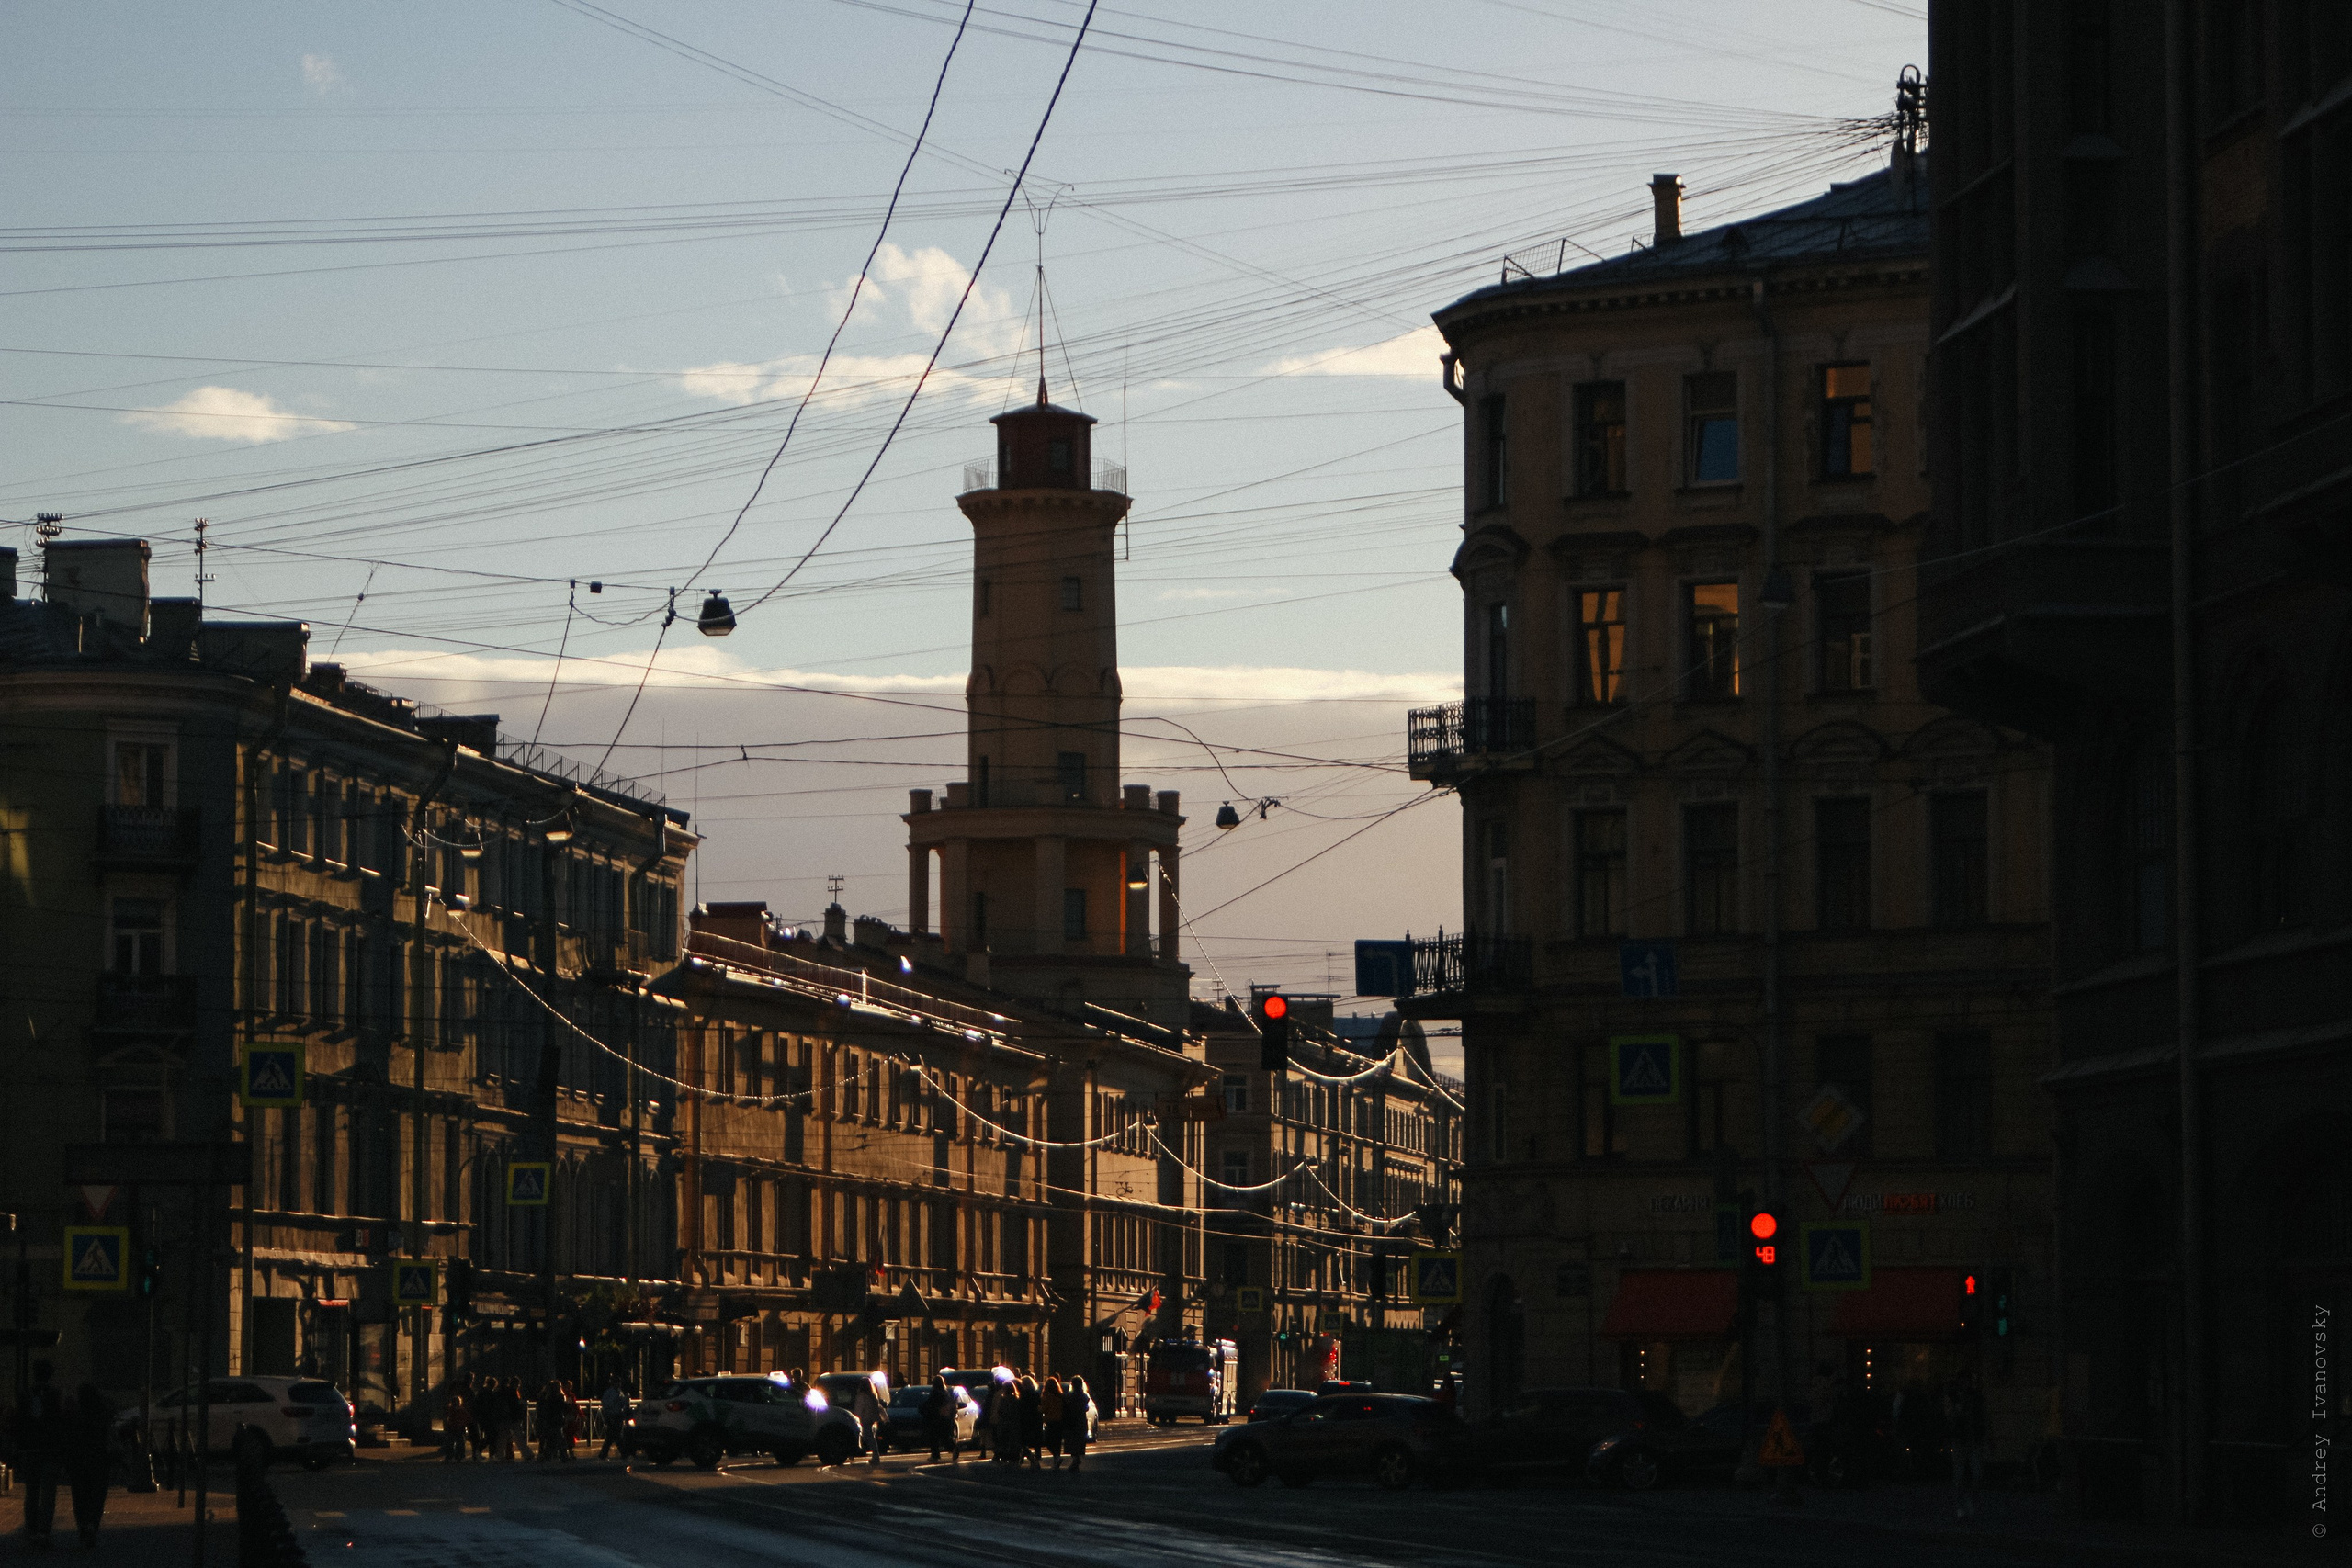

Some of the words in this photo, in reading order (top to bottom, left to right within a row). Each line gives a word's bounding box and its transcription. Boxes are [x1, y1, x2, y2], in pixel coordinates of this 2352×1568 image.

[1650, 1195, 1711, 1213] ПЕКАРНЯ
[1842, 1194, 1882, 1211] ЛЮДИ
[1938, 1191, 1974, 1210] ХЛЕБ
[1755, 1245, 1776, 1265] 48
